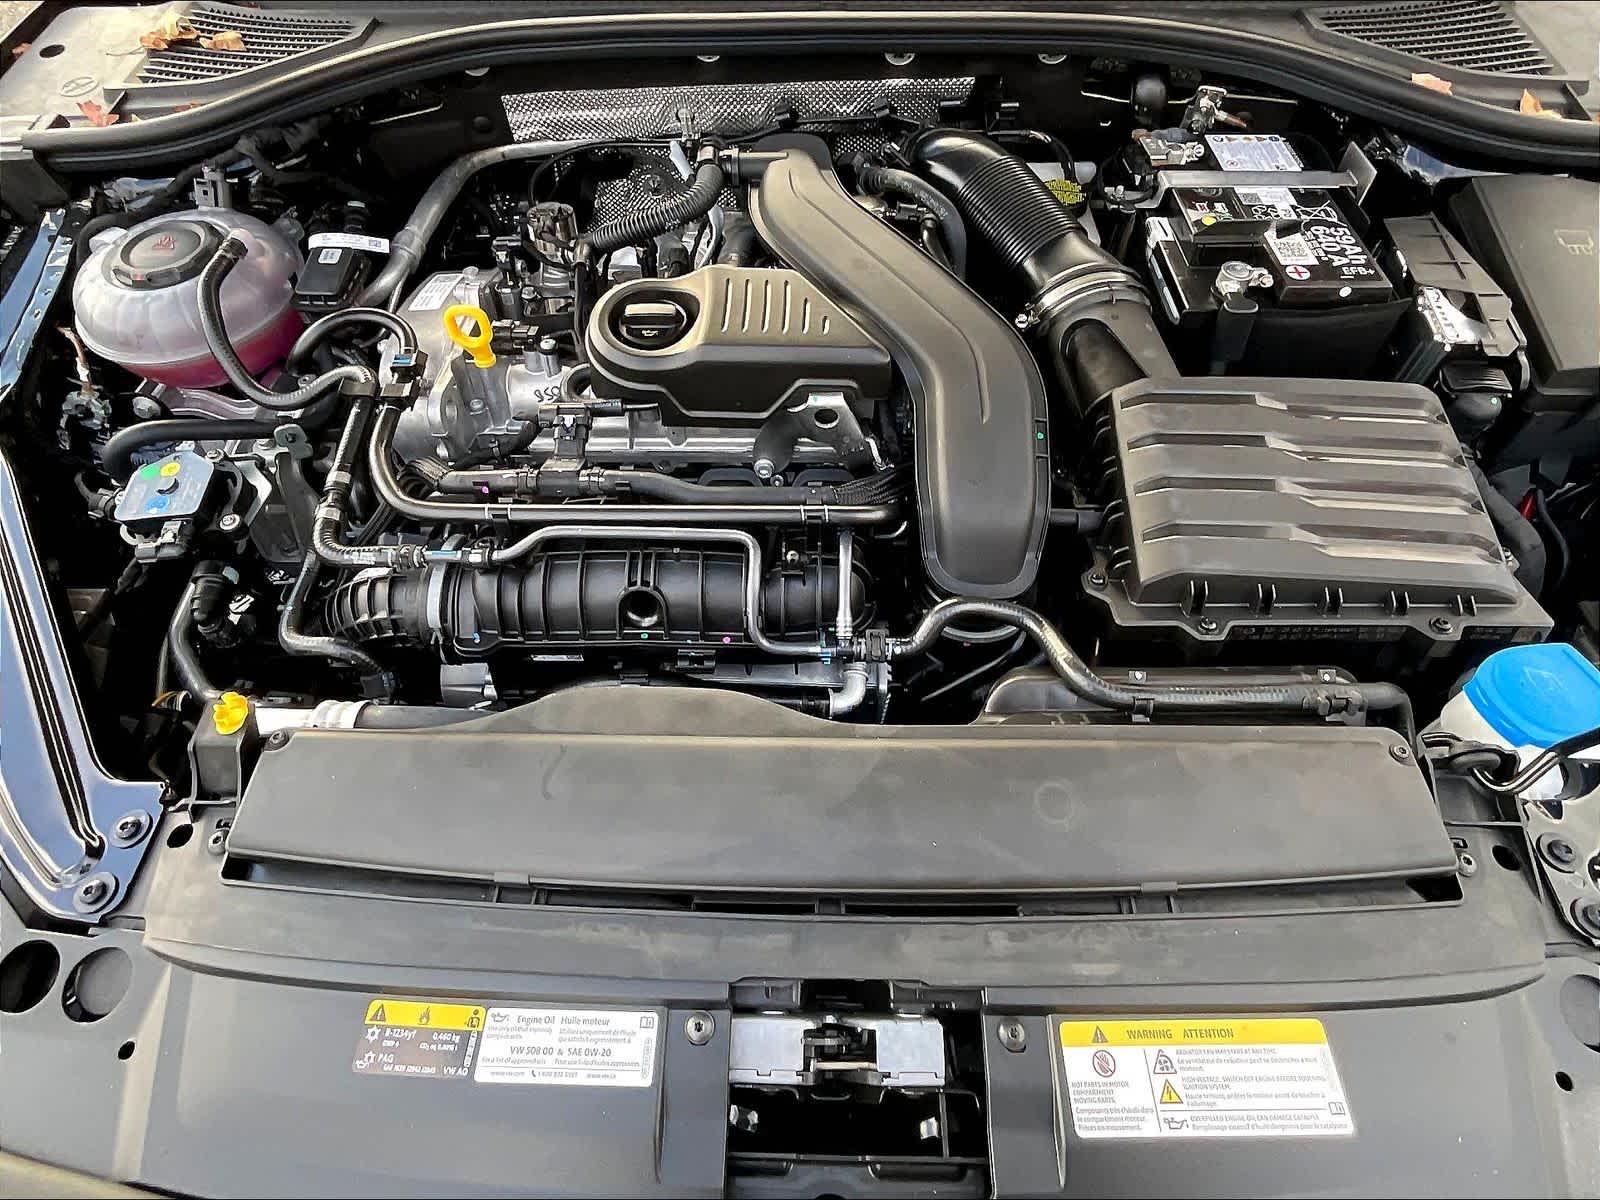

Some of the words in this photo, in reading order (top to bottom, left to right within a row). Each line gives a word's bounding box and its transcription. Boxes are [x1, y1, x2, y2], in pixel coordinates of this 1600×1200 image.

[518, 1015, 543, 1026] Engine
[544, 1015, 555, 1024] Oil
[561, 1015, 581, 1026] Huile
[582, 1017, 610, 1026] moteur
[1126, 1028, 1173, 1040] WARNING
[1183, 1028, 1234, 1039] ATTENTION
[510, 1046, 525, 1055] VW
[526, 1046, 541, 1056] 508
[542, 1047, 554, 1056] 00
[557, 1047, 564, 1057] &
[568, 1047, 582, 1057] SAE
[584, 1048, 612, 1057] 0W-20
